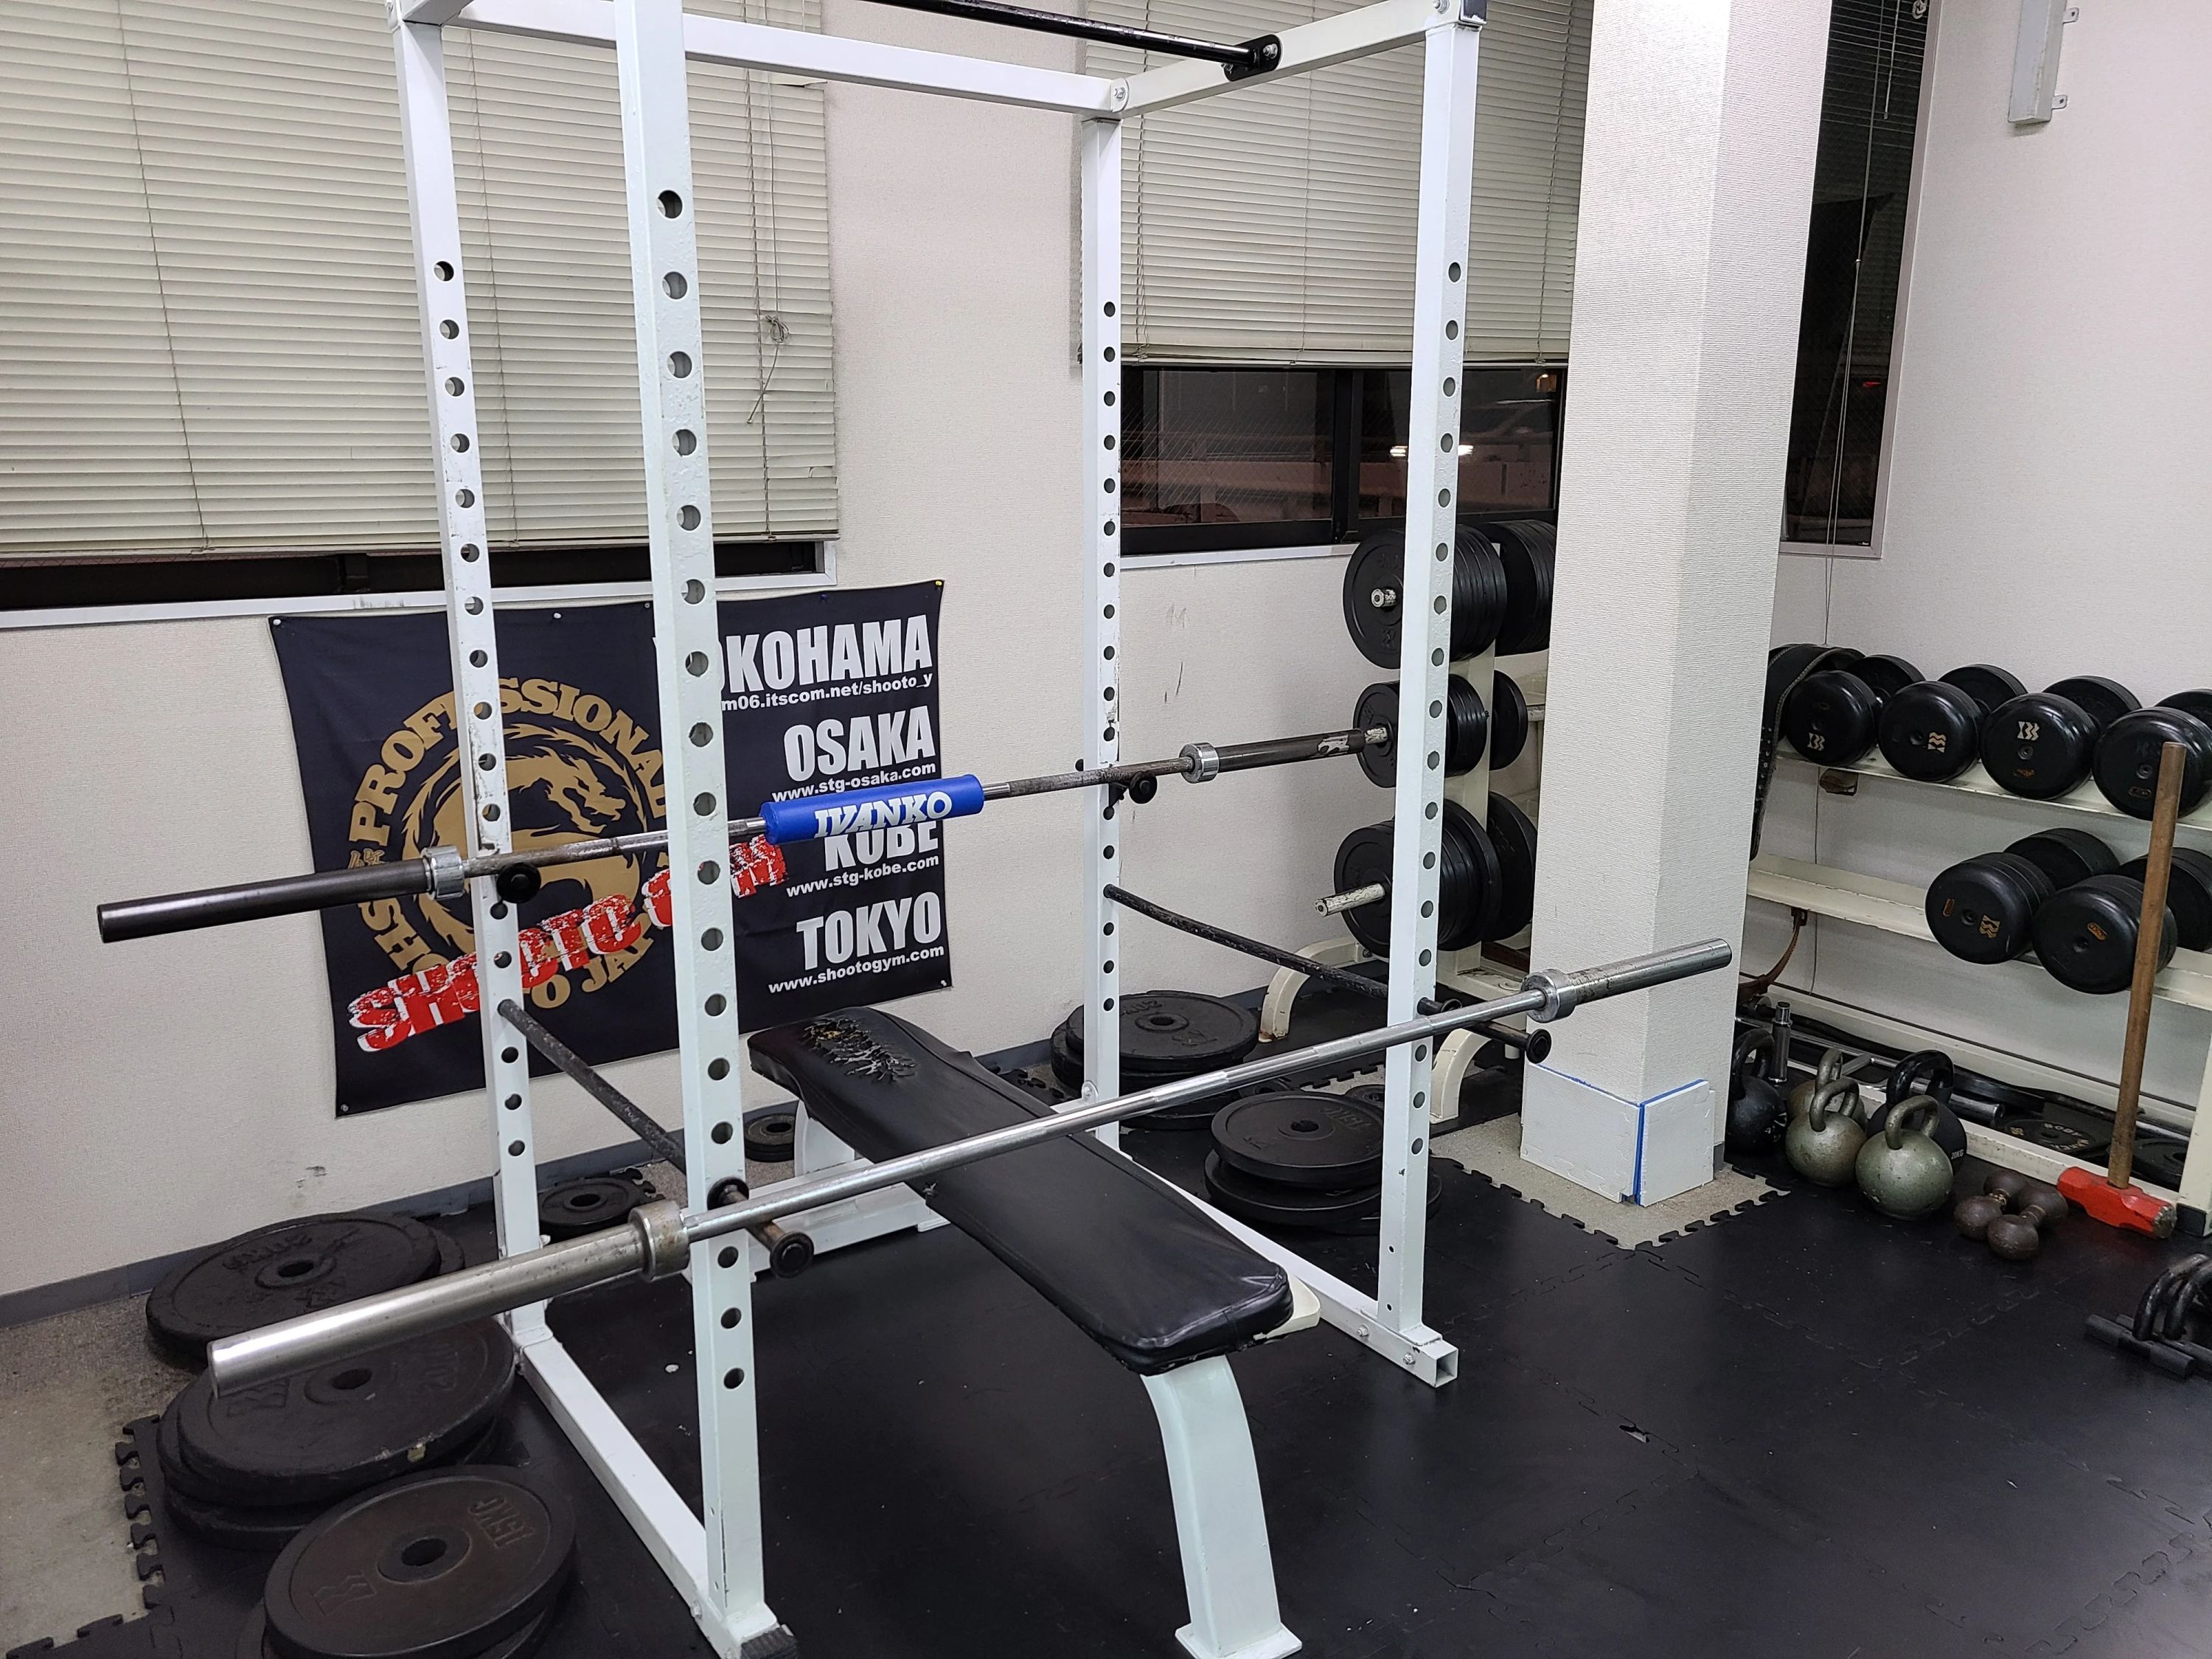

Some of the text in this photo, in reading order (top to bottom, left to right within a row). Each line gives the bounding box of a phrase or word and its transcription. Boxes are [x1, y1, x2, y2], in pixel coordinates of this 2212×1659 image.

[652, 614, 933, 694] KOHAMA
[784, 705, 936, 782] OSAKA
[772, 762, 936, 802] www.stg-osaka.com
[813, 791, 953, 838] IVANKO
[824, 820, 939, 872] KOBE
[787, 854, 939, 898] www.stg-kobe.com
[796, 891, 942, 971] TOKYO
[768, 945, 945, 993] www.shootogym.com
